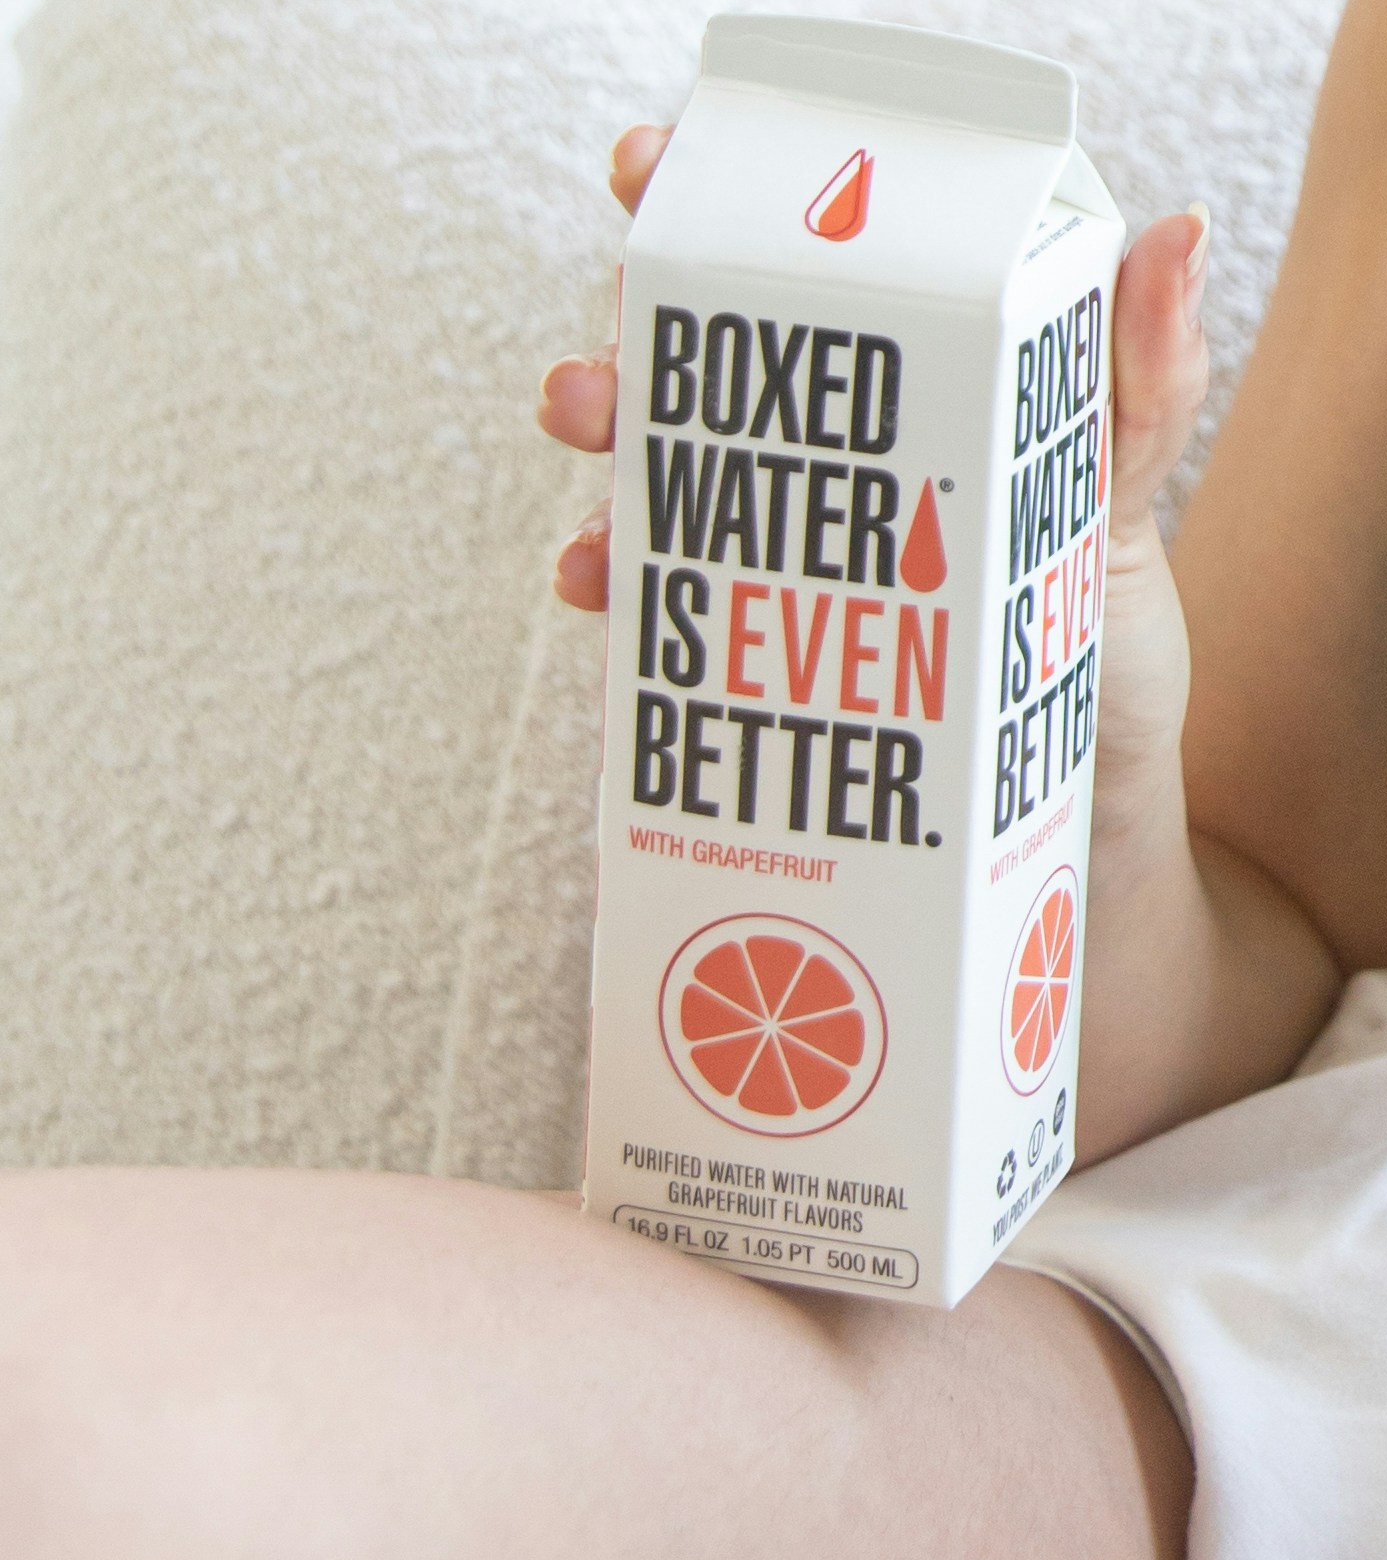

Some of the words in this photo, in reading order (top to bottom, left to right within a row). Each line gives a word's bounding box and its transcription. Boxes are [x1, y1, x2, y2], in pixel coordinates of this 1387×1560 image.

[650, 304, 902, 455] BOXED
[1013, 286, 1101, 460] BOXED
[647, 434, 899, 588] WATER
[1009, 409, 1099, 586] WATER
[638, 562, 711, 687] IS
[726, 579, 950, 722] EVEN
[1000, 583, 1034, 715] IS
[1040, 513, 1106, 684] EVEN
[633, 688, 943, 848] BETTER.
[990, 845, 1019, 886] WITH
[1022, 792, 1075, 862] GRAPEFRUIT
[628, 825, 685, 860] WITH
[692, 839, 839, 884] GRAPEFRUIT
[623, 1143, 701, 1179] PURIFIED
[708, 1159, 765, 1191] WATER
[772, 1170, 820, 1199] WITH
[826, 1178, 909, 1210] NATURAL
[627, 1216, 669, 1242] 16.9
[674, 1225, 699, 1247] FL
[704, 1230, 730, 1252] OZ
[742, 1236, 783, 1260] 1.05
[789, 1243, 815, 1265] PT
[827, 1250, 866, 1273] 500
[872, 1256, 904, 1279] ML
[668, 1180, 778, 1220] GRAPEFRUIT
[784, 1201, 864, 1233] FLAVORS
[992, 1210, 1010, 1247] YOU
[1009, 1187, 1029, 1228] POST
